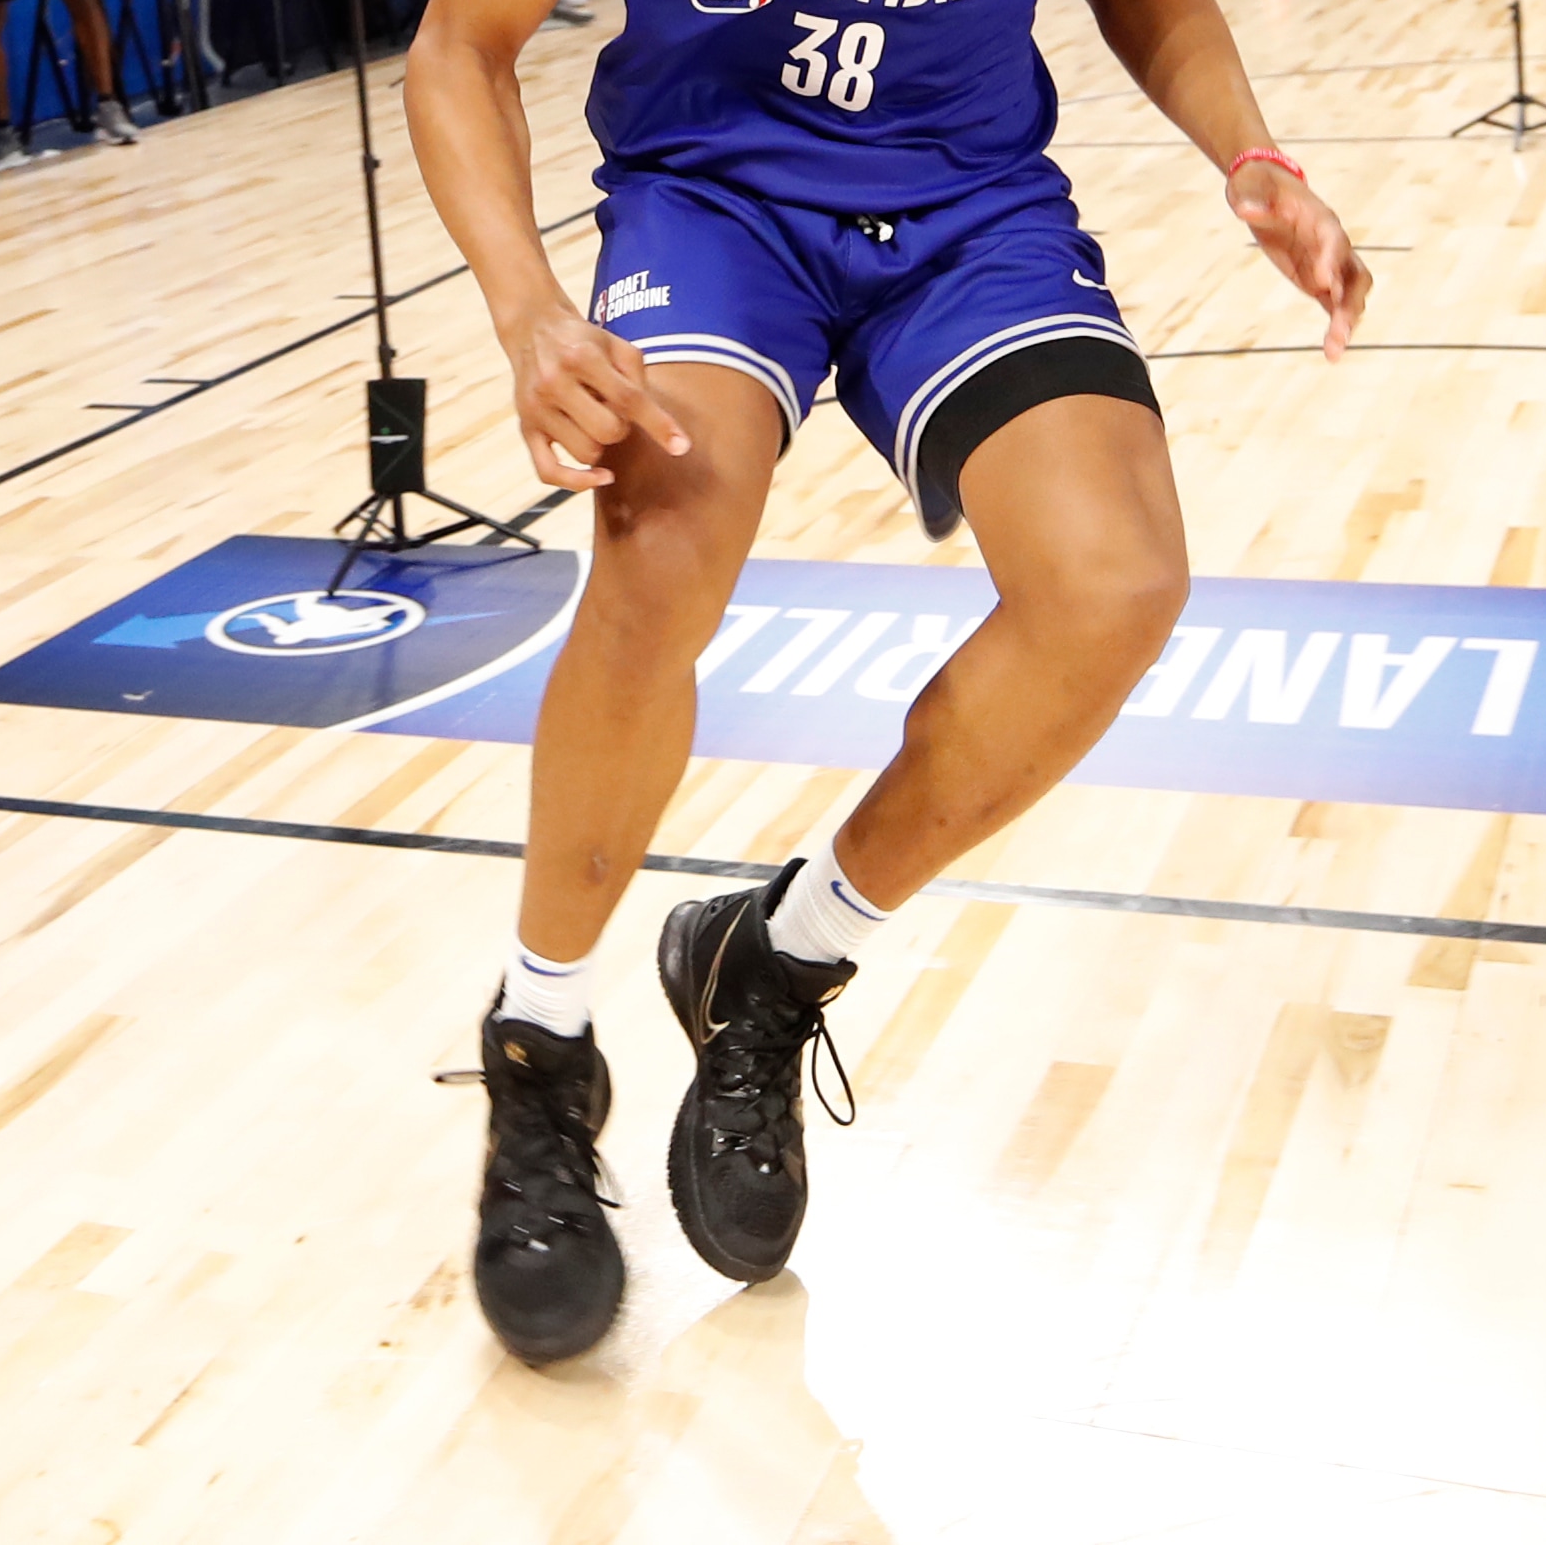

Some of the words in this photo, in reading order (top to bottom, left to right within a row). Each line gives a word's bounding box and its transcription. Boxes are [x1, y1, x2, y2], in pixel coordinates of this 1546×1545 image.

[780, 11, 886, 113] 38
[605, 285, 672, 323] COMBINE
[607, 269, 650, 304] DRAFT
[695, 603, 986, 702] RILL
[1119, 625, 1540, 737] LANE
